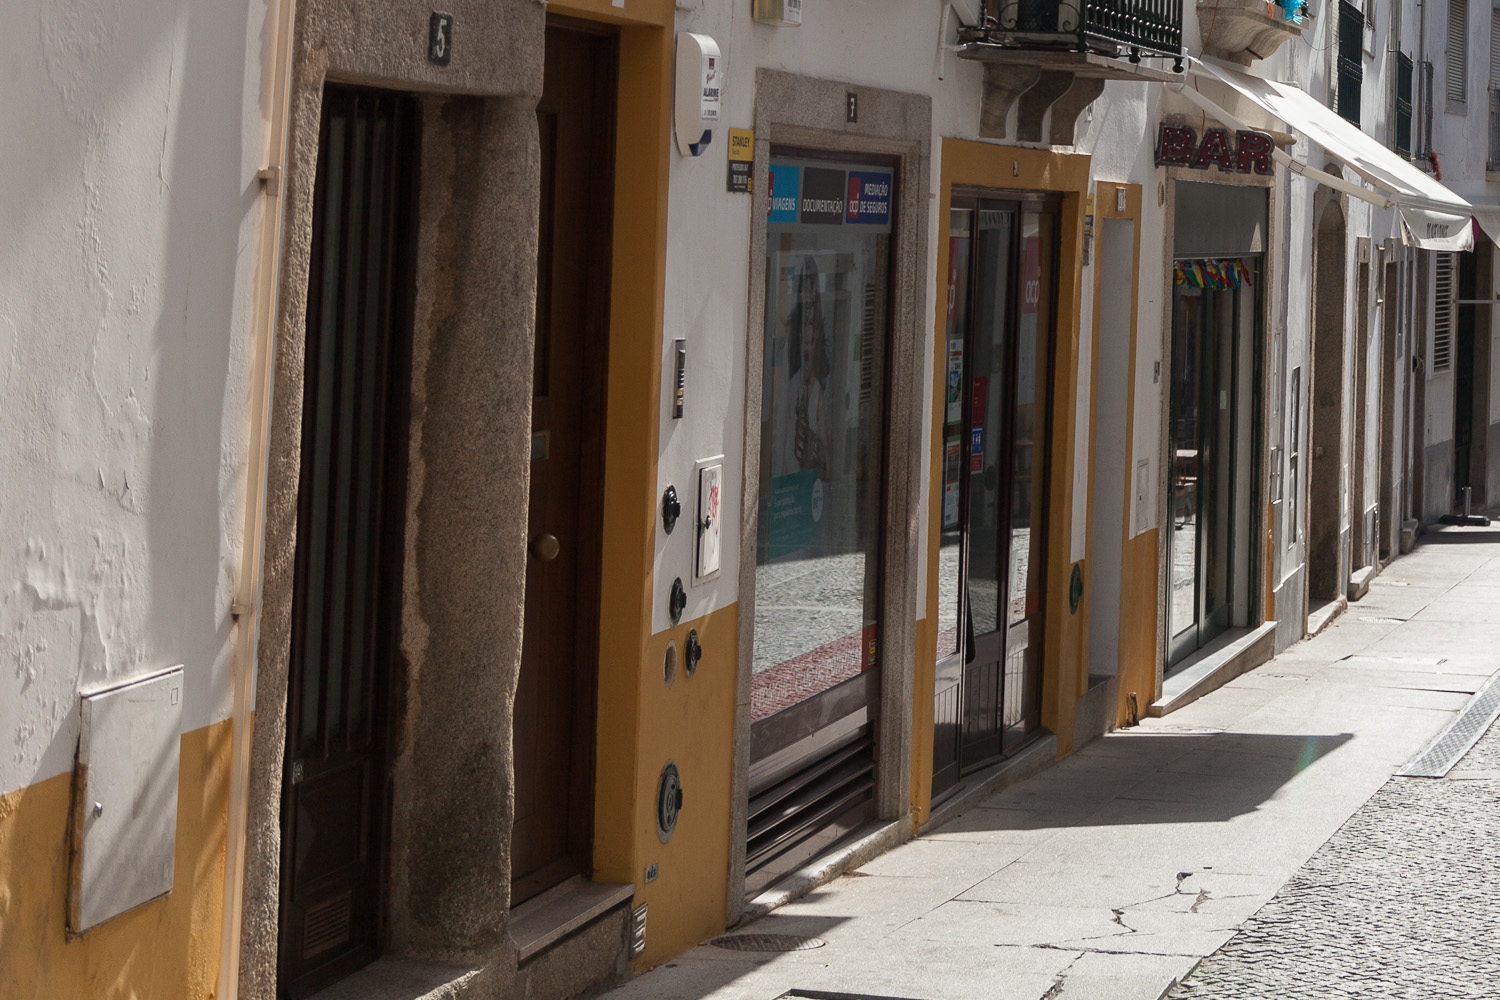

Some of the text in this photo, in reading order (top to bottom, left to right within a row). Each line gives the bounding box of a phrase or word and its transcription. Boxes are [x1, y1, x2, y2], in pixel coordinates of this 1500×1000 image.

[436, 18, 447, 58] 5
[1155, 122, 1275, 176] BAR
[772, 197, 796, 211] VIAGENS
[802, 197, 843, 216] DOCUMENTAÇÃO
[1026, 280, 1039, 308] acp
